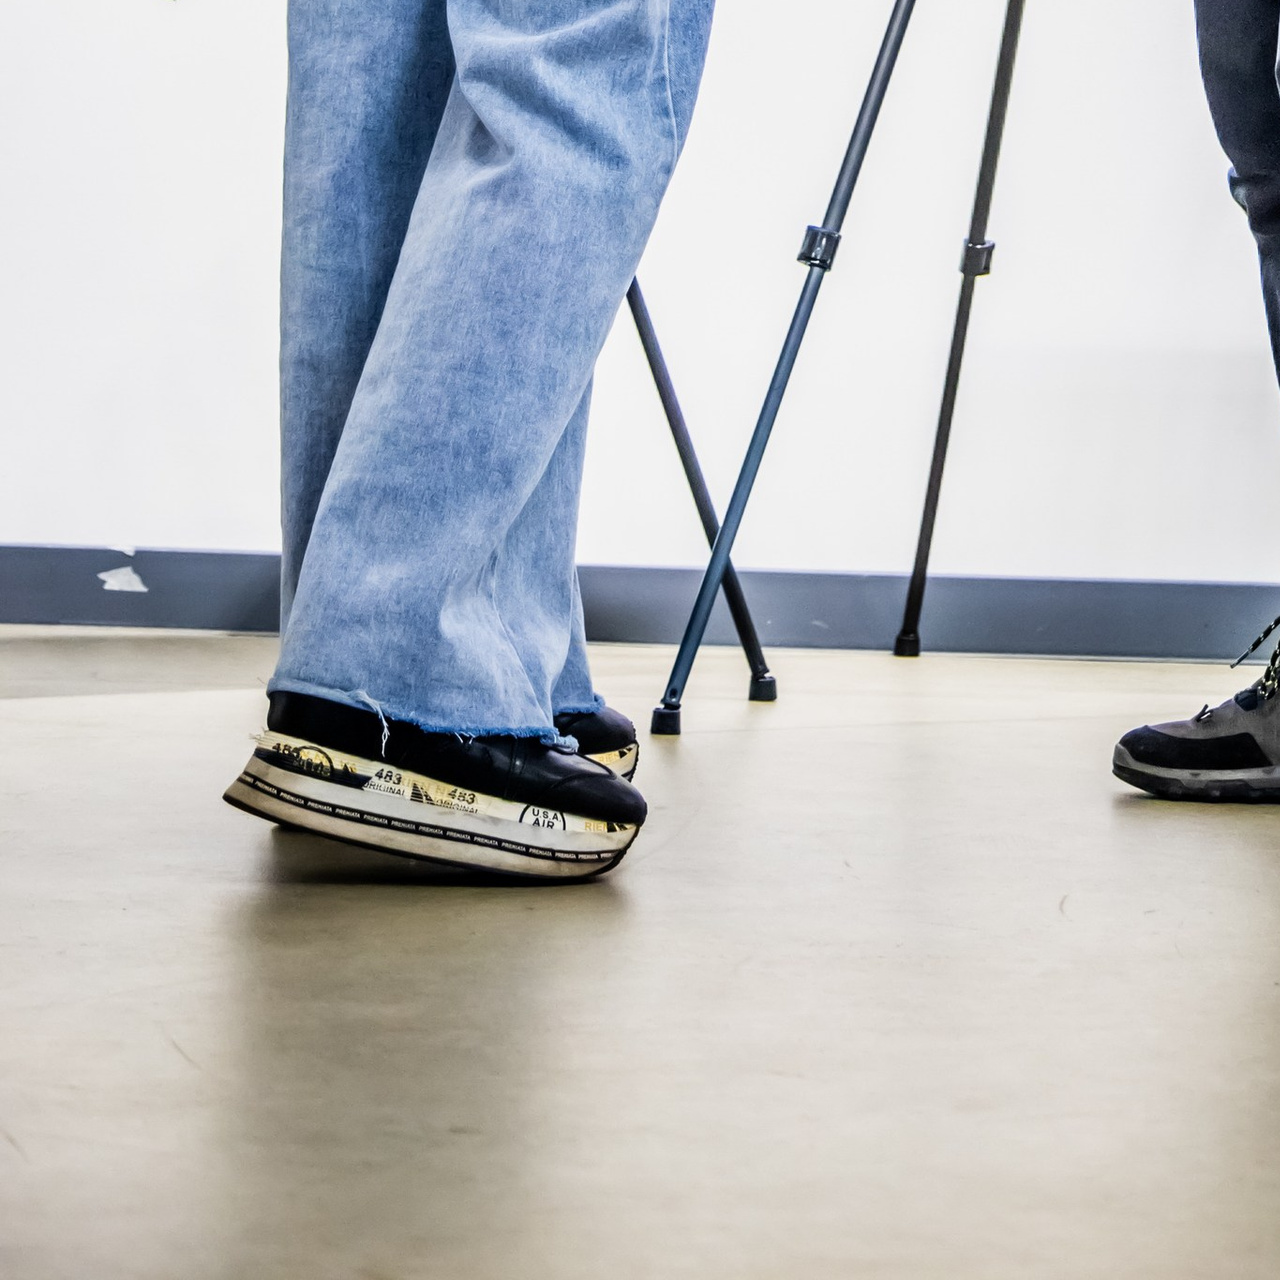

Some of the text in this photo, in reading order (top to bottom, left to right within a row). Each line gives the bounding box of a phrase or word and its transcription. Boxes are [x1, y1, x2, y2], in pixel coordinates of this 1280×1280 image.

[375, 768, 402, 785] 483
[532, 807, 562, 822] U.S.A.
[532, 817, 555, 829] AIR
